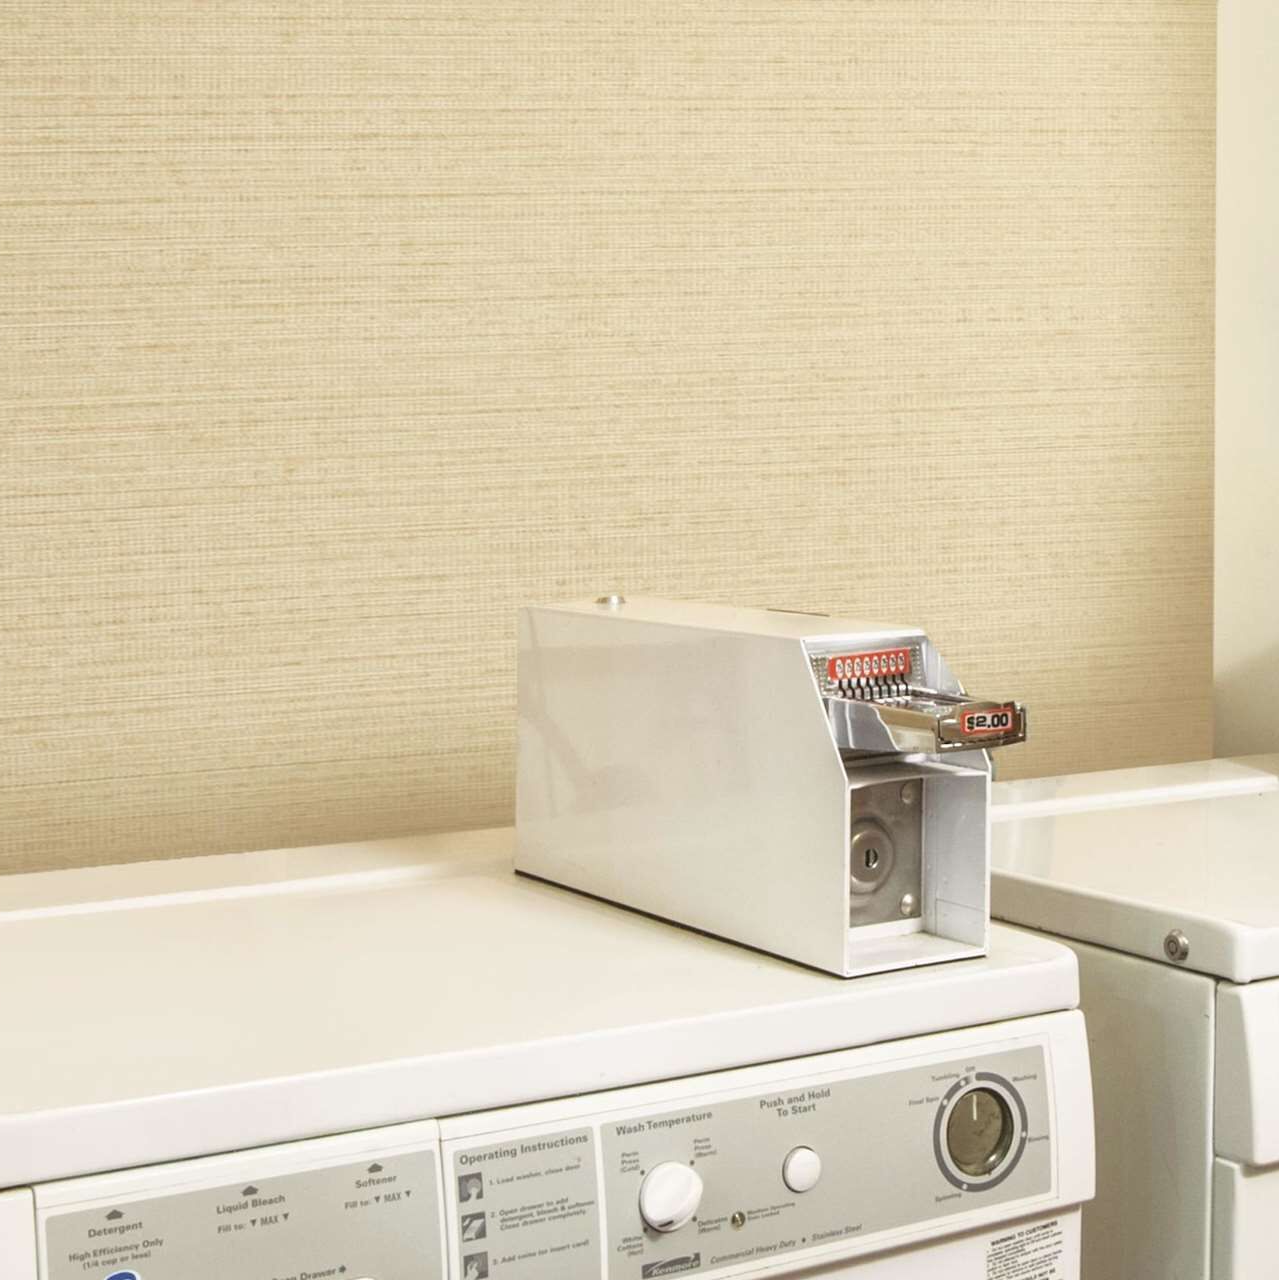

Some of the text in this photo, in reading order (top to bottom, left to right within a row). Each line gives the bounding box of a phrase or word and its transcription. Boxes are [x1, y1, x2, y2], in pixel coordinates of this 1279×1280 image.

[967, 713, 1009, 730] $2.00
[759, 1087, 831, 1109] Push and Hold
[776, 1103, 816, 1117] To Start
[616, 1111, 713, 1136] Wash Temperature
[459, 1132, 588, 1165] Operating Instructions
[354, 1175, 397, 1189] Softener
[216, 1194, 286, 1215] Liquid Bleach
[344, 1201, 357, 1210] Fill
[383, 1191, 402, 1203] MAX
[88, 1221, 143, 1238] Detergent
[217, 1225, 232, 1234] Fill
[260, 1215, 279, 1227] MAX
[69, 1237, 164, 1262] High Efficiency Only
[710, 1223, 862, 1265] Commercial Heavy Duty Stainless Steel
